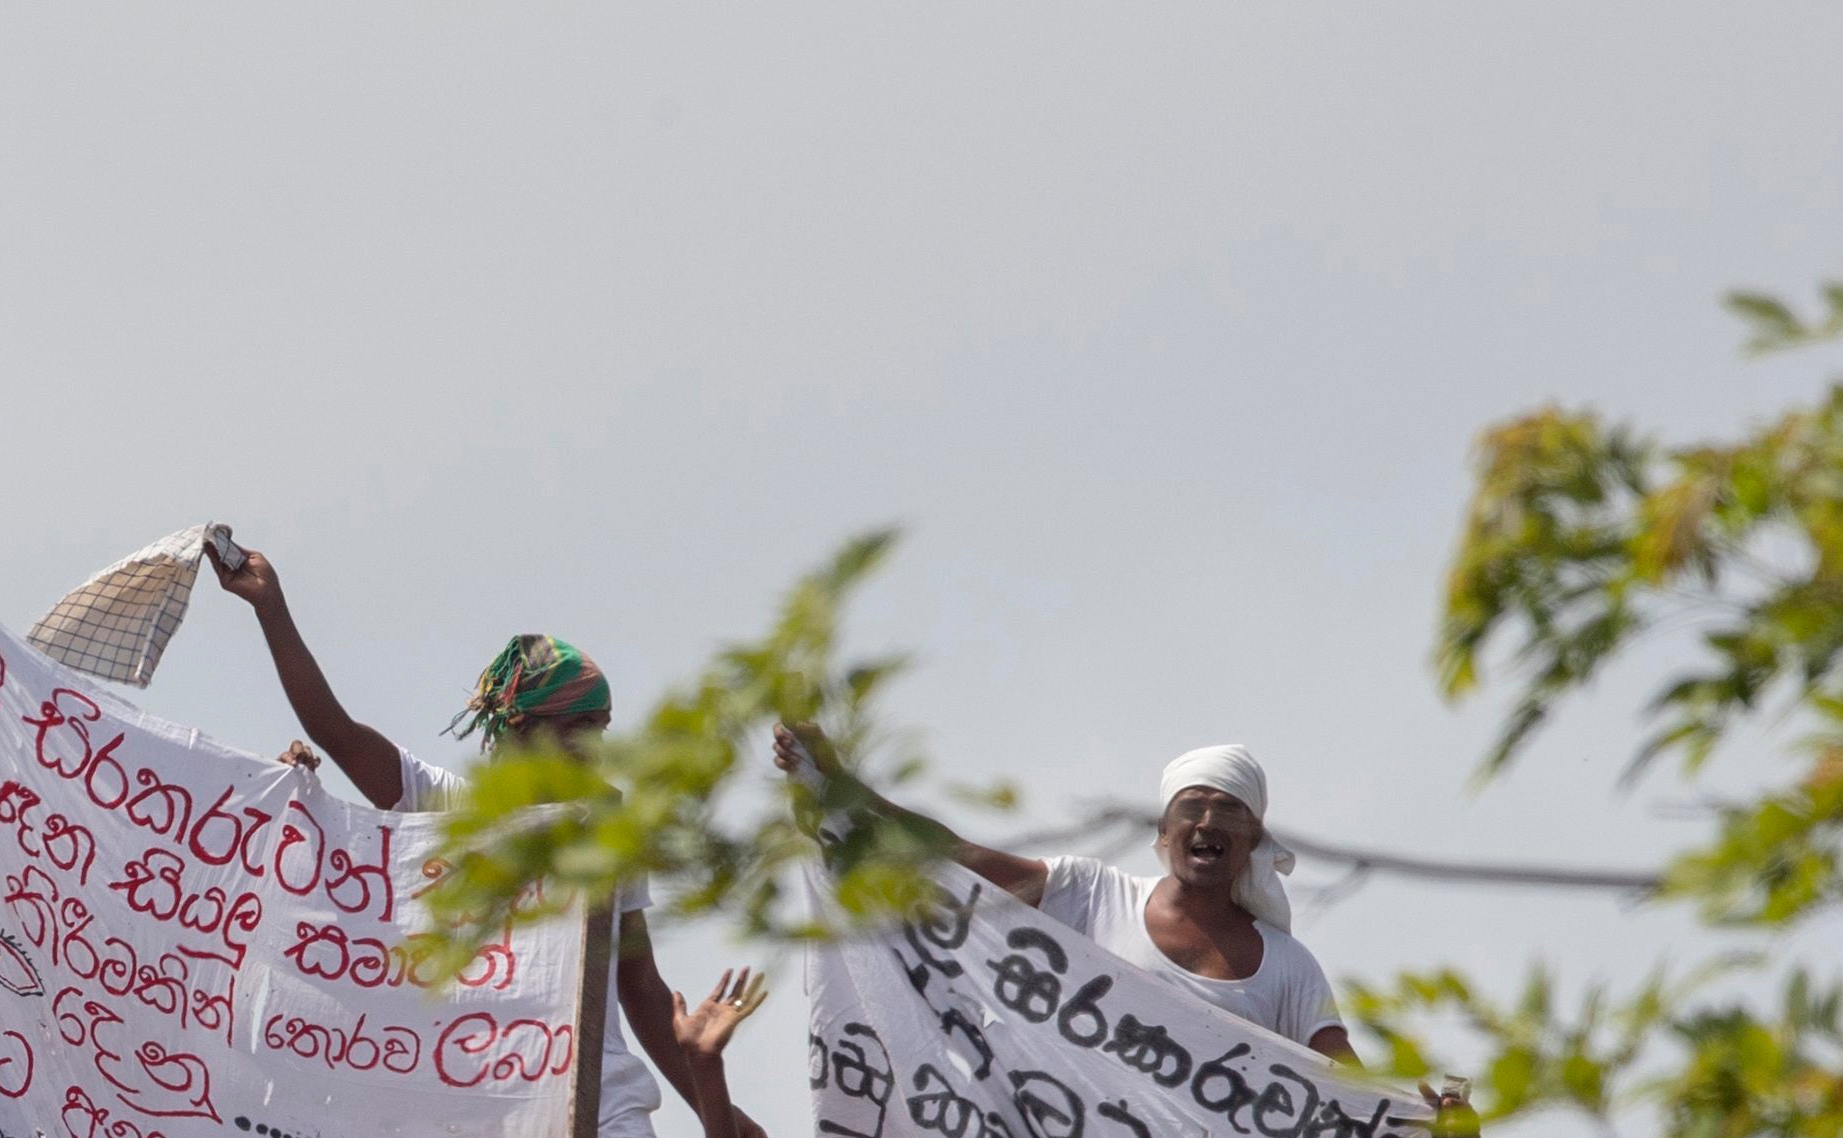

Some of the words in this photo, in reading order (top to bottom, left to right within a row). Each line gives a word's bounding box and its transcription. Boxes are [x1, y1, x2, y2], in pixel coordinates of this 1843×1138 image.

[109, 847, 262, 970] සියලු
[265, 1013, 421, 1073] තොරව
[433, 1012, 574, 1088] ලබා
